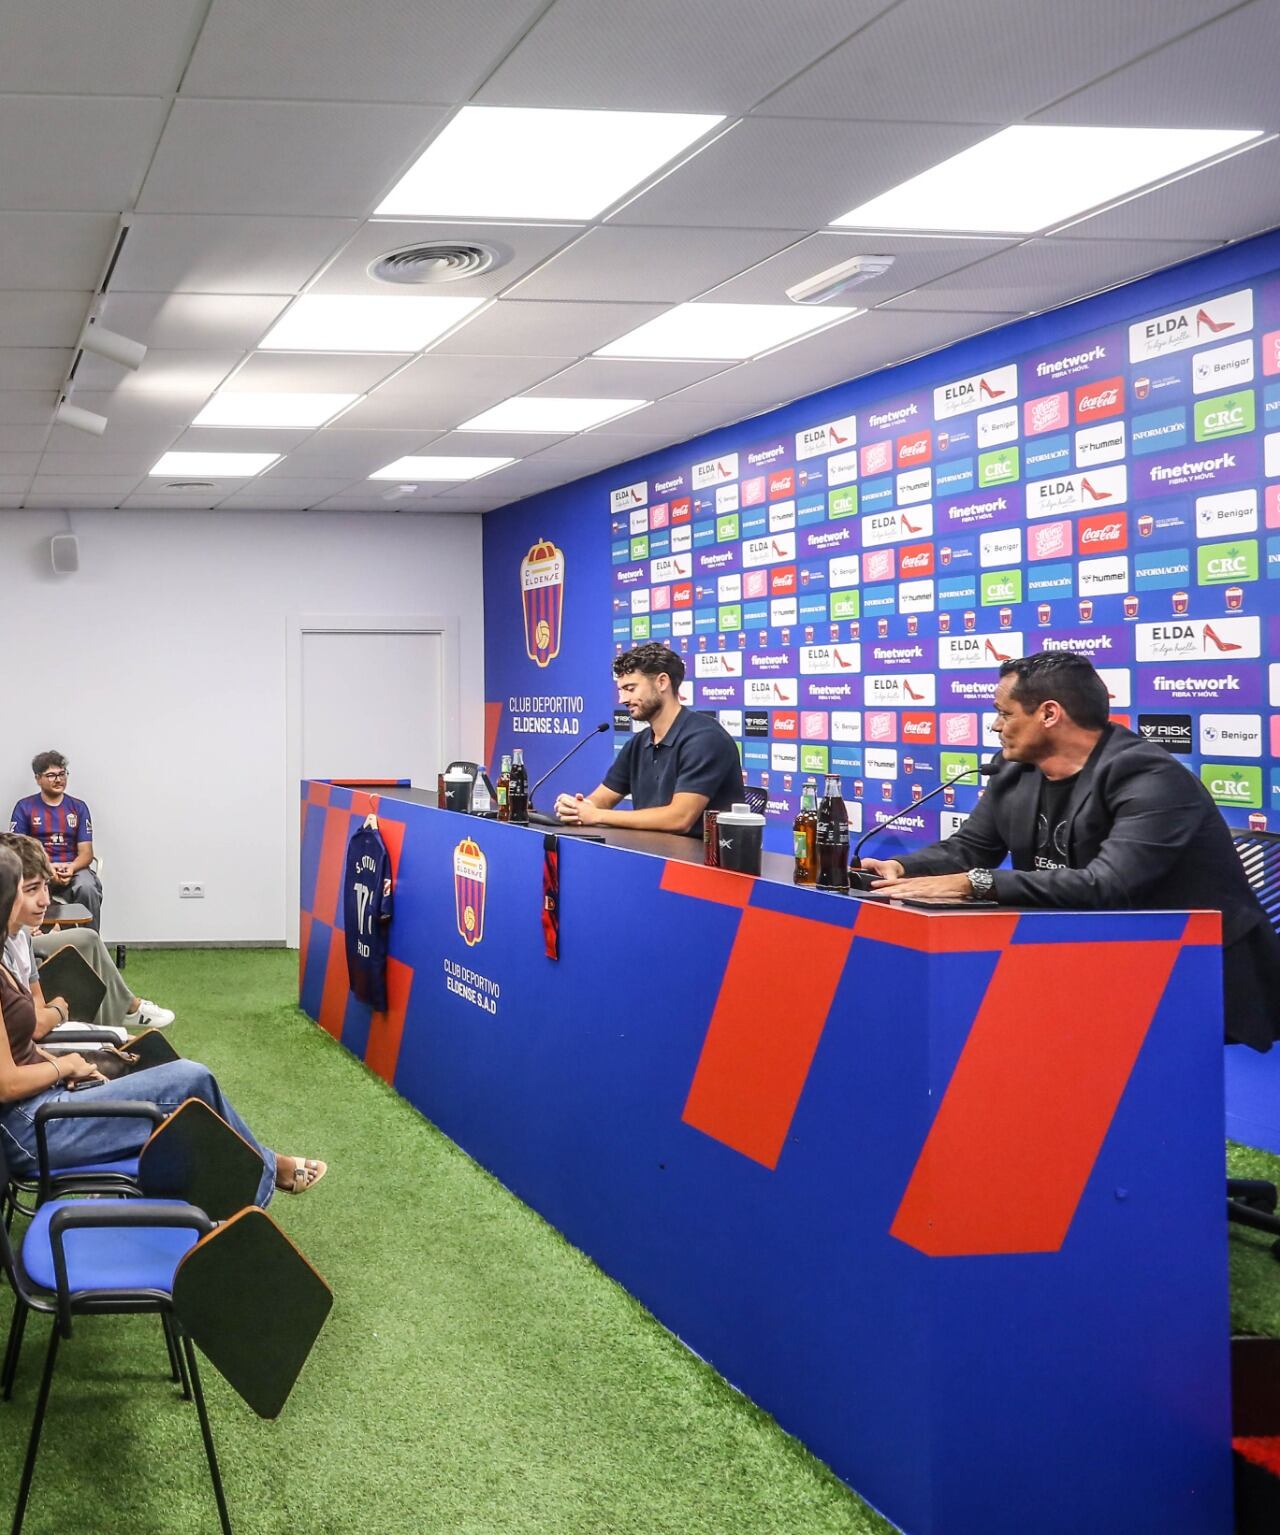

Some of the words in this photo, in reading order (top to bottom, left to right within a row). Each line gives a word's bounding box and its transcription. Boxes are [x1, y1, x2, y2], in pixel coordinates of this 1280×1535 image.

[1146, 316, 1188, 338] ELDA
[1036, 346, 1106, 376] finetwork
[1214, 358, 1250, 372] Benigar
[945, 383, 974, 400] ELDA
[869, 403, 918, 427] finetwork
[1204, 408, 1243, 429] CRC
[991, 420, 1016, 431] Benigar
[1133, 422, 1185, 440] INFORMACIÓN
[804, 430, 826, 444] ELDA
[1090, 437, 1123, 451] hummel
[748, 445, 785, 464] finetwork
[1026, 448, 1069, 464] INFORMACIÓN
[698, 464, 715, 475] ELDA
[985, 461, 1011, 477] CRC
[1150, 453, 1236, 481] finetwork
[655, 476, 683, 492] finetwork
[1169, 477, 1188, 486] FIBRA
[1194, 472, 1216, 481] MÓVIL
[615, 490, 629, 501] ELDA
[1040, 481, 1075, 498] ELDA
[833, 497, 853, 511] CRC
[948, 497, 1007, 520] finetwork
[1217, 508, 1254, 519] Benigar
[872, 516, 896, 529] ELDA
[808, 528, 850, 545] finetwork
[750, 541, 768, 553] ELDA
[656, 560, 671, 570] ELDA
[701, 551, 733, 566] finetwork
[1207, 556, 1247, 575] CRC
[617, 568, 644, 581] finetwork
[1093, 571, 1126, 584] hummel
[1136, 564, 1189, 578] INFORMACIÓN
[987, 583, 1015, 597] CRC
[1152, 626, 1195, 640] ELDA
[950, 639, 980, 651] ELDA
[1042, 635, 1112, 651] finetwork
[808, 649, 829, 659] ELDA
[873, 646, 923, 659] finetwork
[702, 655, 718, 665] ELDA
[751, 654, 789, 666] finetwork
[752, 683, 770, 692] ELDA
[874, 680, 899, 690] ELDA
[951, 681, 1000, 695] finetwo
[1153, 675, 1240, 690] finetwork
[702, 686, 735, 697] finetwork
[808, 684, 851, 696] finetwork
[1198, 690, 1219, 698] MÓVIL
[509, 696, 531, 712] CLUB
[532, 696, 583, 713] DEPORTIVO
[513, 717, 552, 733] ELDENSE
[553, 717, 579, 735] S.A.D
[1158, 725, 1191, 736] RISK
[1221, 730, 1258, 740] Benigar
[1211, 780, 1250, 796] CRC
[444, 959, 460, 978] CLUB
[461, 967, 500, 998] DEPORTIVO
[447, 976, 477, 1004] ELDENSE
[477, 992, 497, 1015] S.A.D
